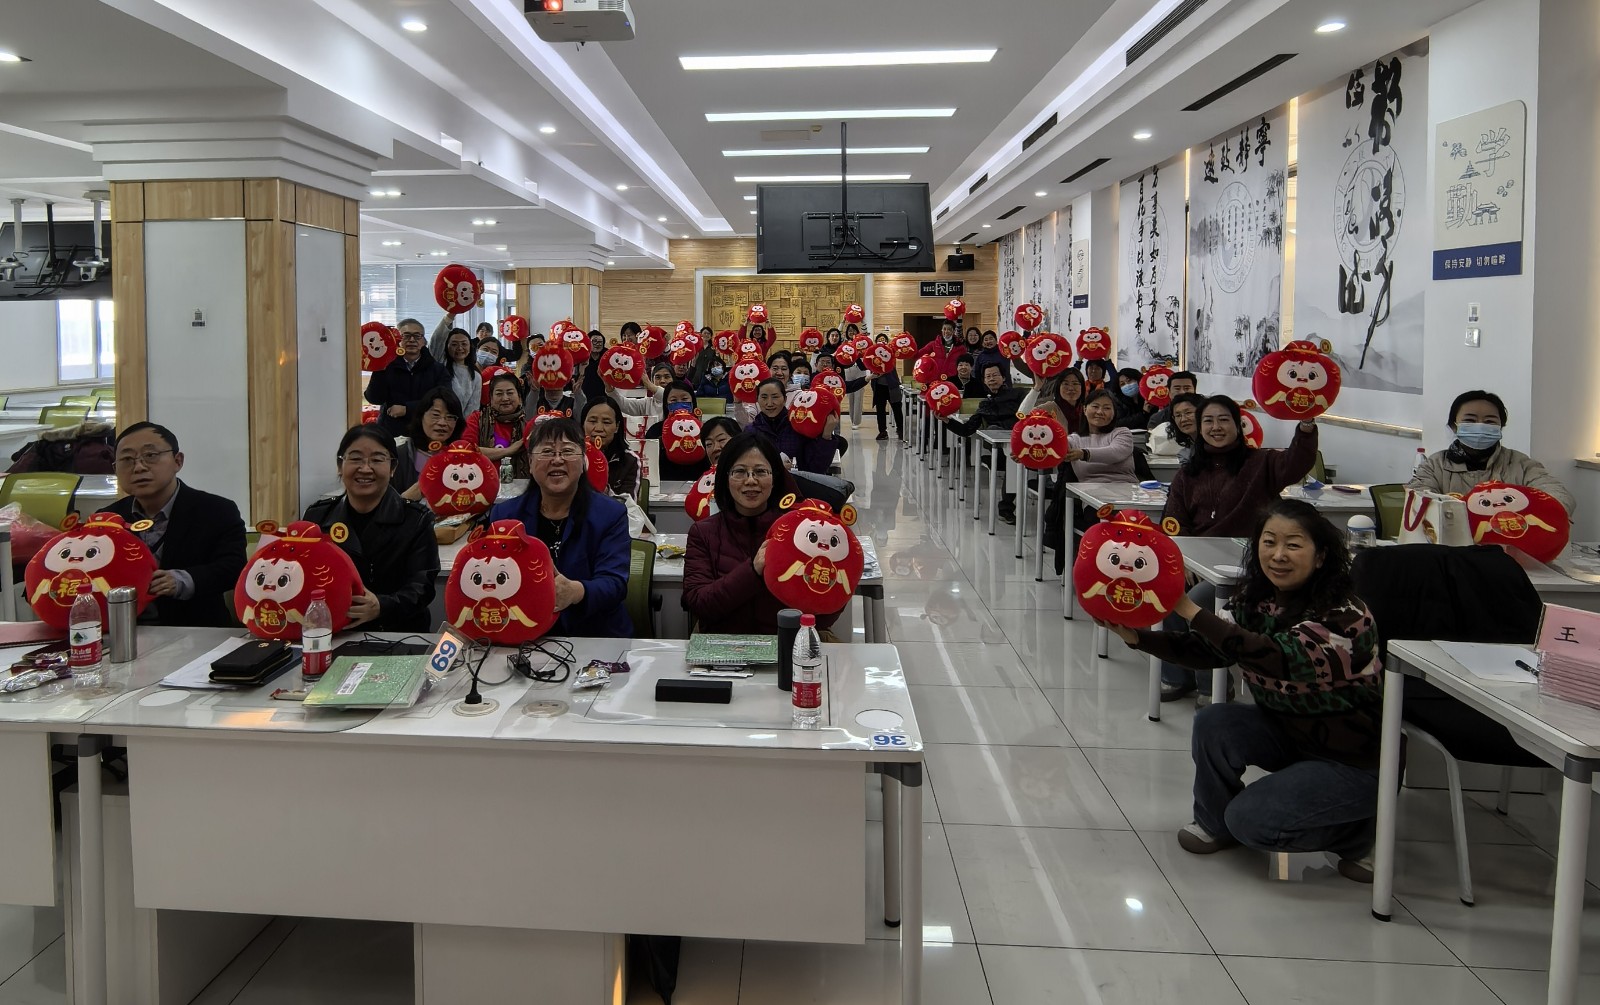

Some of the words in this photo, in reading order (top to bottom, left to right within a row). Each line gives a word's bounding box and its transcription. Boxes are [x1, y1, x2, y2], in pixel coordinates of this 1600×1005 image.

[1476, 127, 1511, 178] 学
[1445, 182, 1479, 230] 勤
[1444, 257, 1472, 269] 保持安静
[744, 380, 754, 390] 福
[1294, 390, 1311, 406] 福
[683, 439, 696, 450] 福
[1032, 448, 1045, 460] 福
[455, 491, 471, 506] 福
[1501, 517, 1523, 532] 福
[811, 565, 830, 586] 福
[1113, 584, 1134, 605] 福
[260, 608, 280, 627] 福
[480, 606, 503, 626] 福
[1554, 626, 1580, 644] 王
[432, 640, 457, 671] 69
[873, 735, 907, 746] 36
